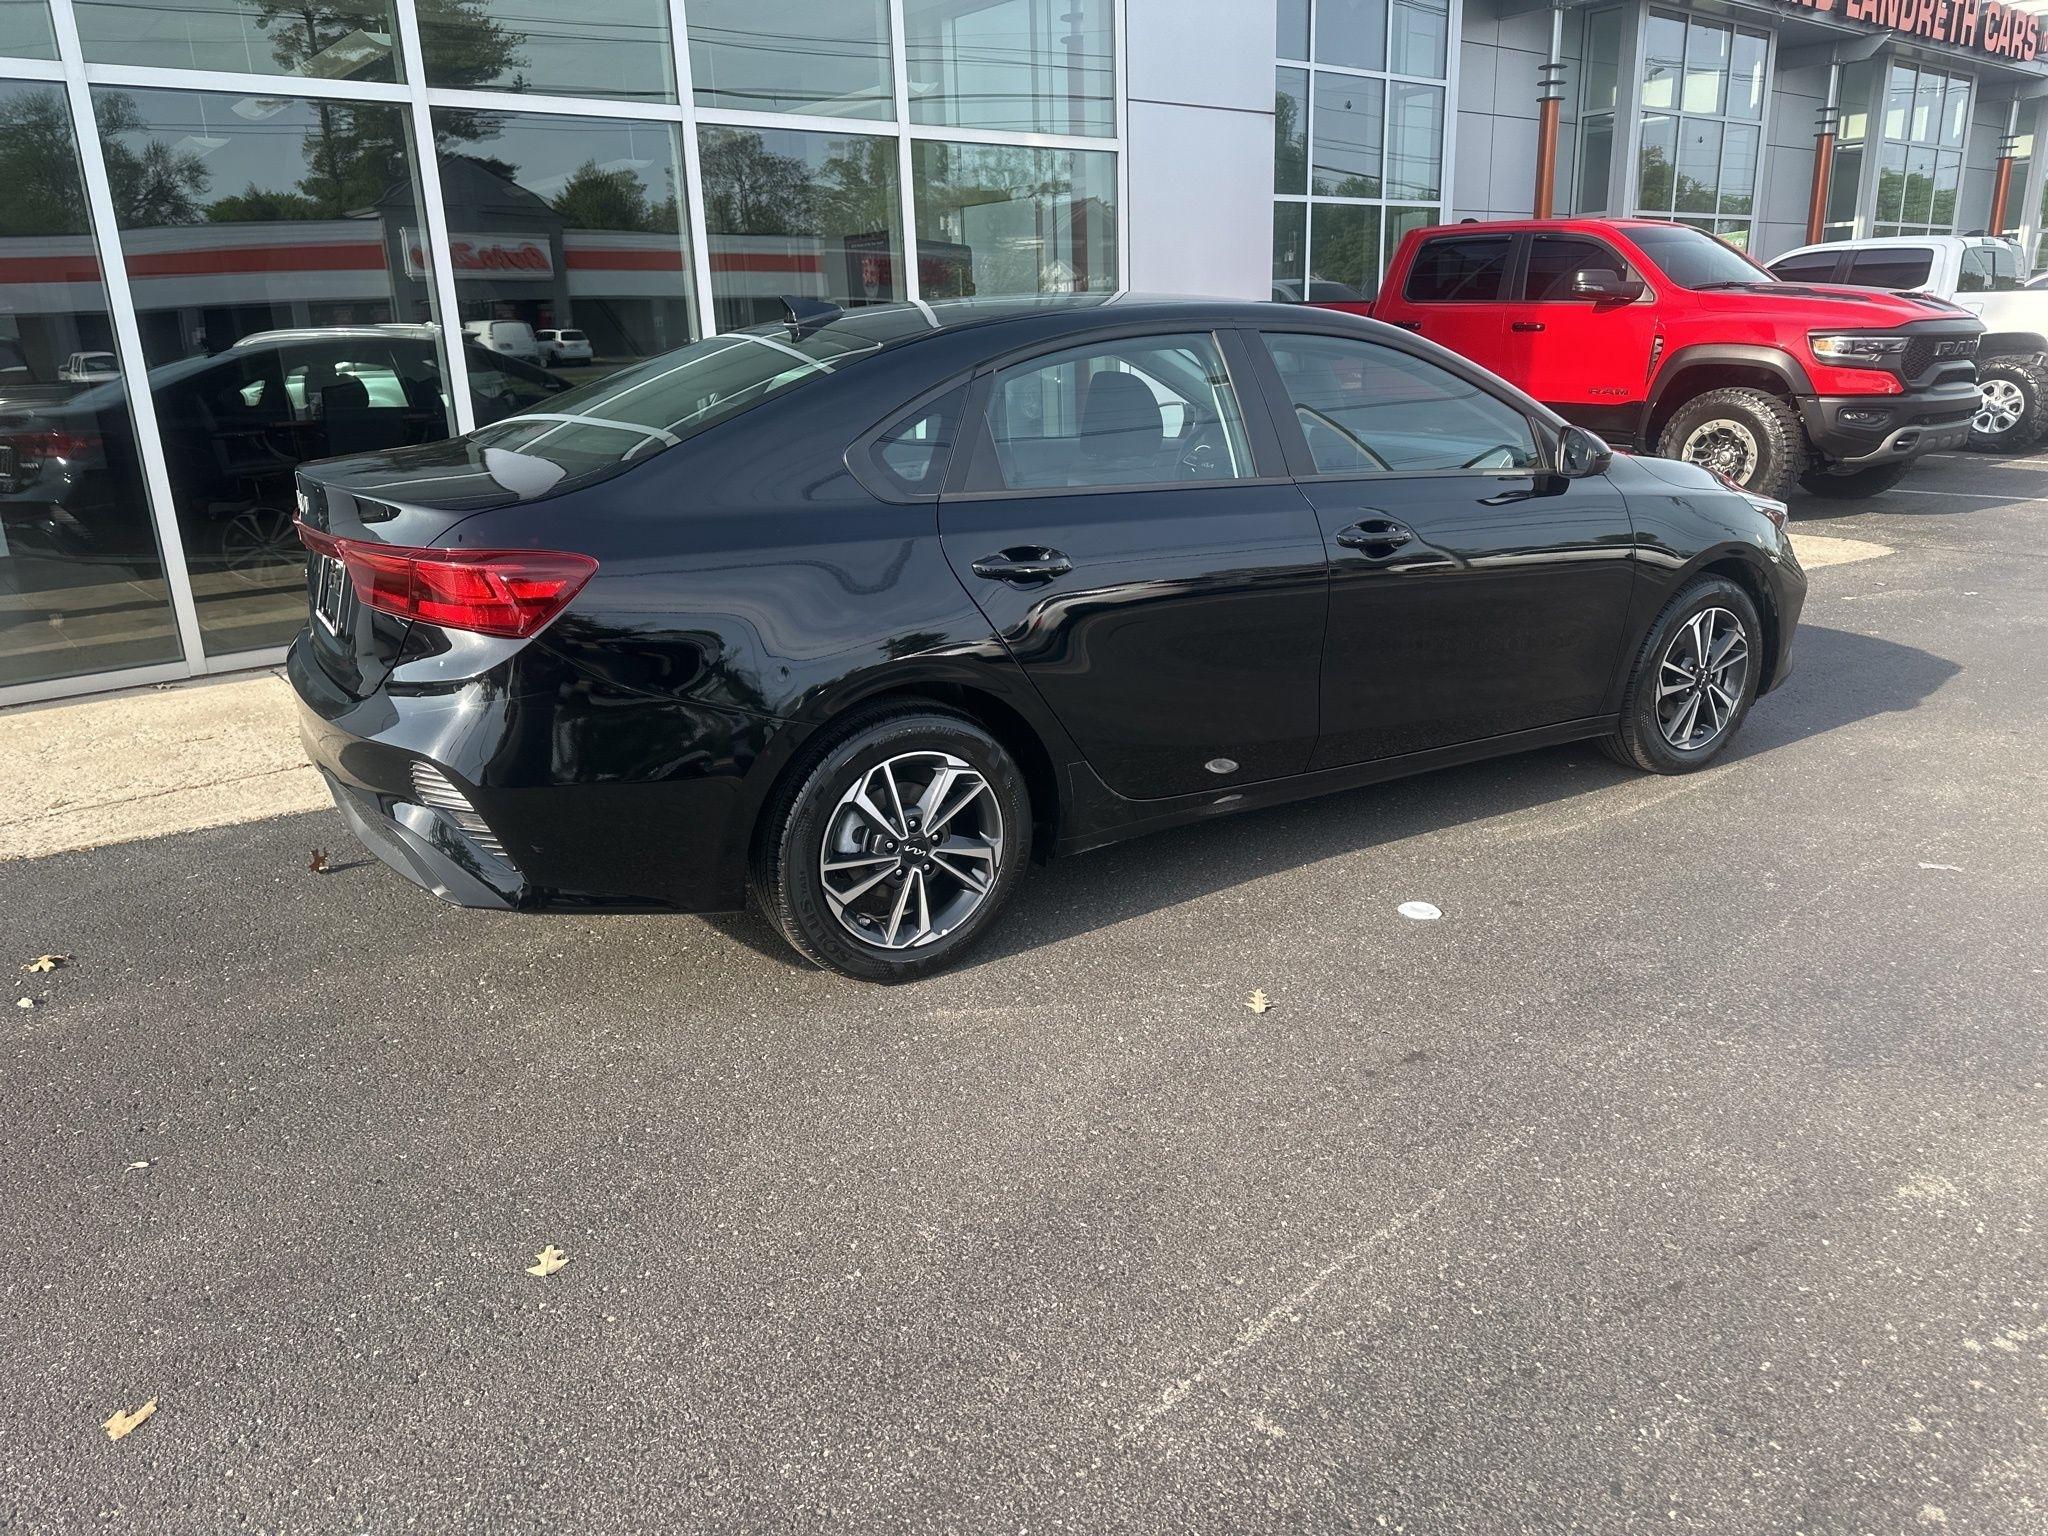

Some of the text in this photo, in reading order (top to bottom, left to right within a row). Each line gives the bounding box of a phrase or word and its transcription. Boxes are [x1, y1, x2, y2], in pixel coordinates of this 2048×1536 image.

[1984, 1, 2039, 62] CARS
[1934, 340, 1979, 356] RAM
[1588, 387, 1630, 397] RAM
